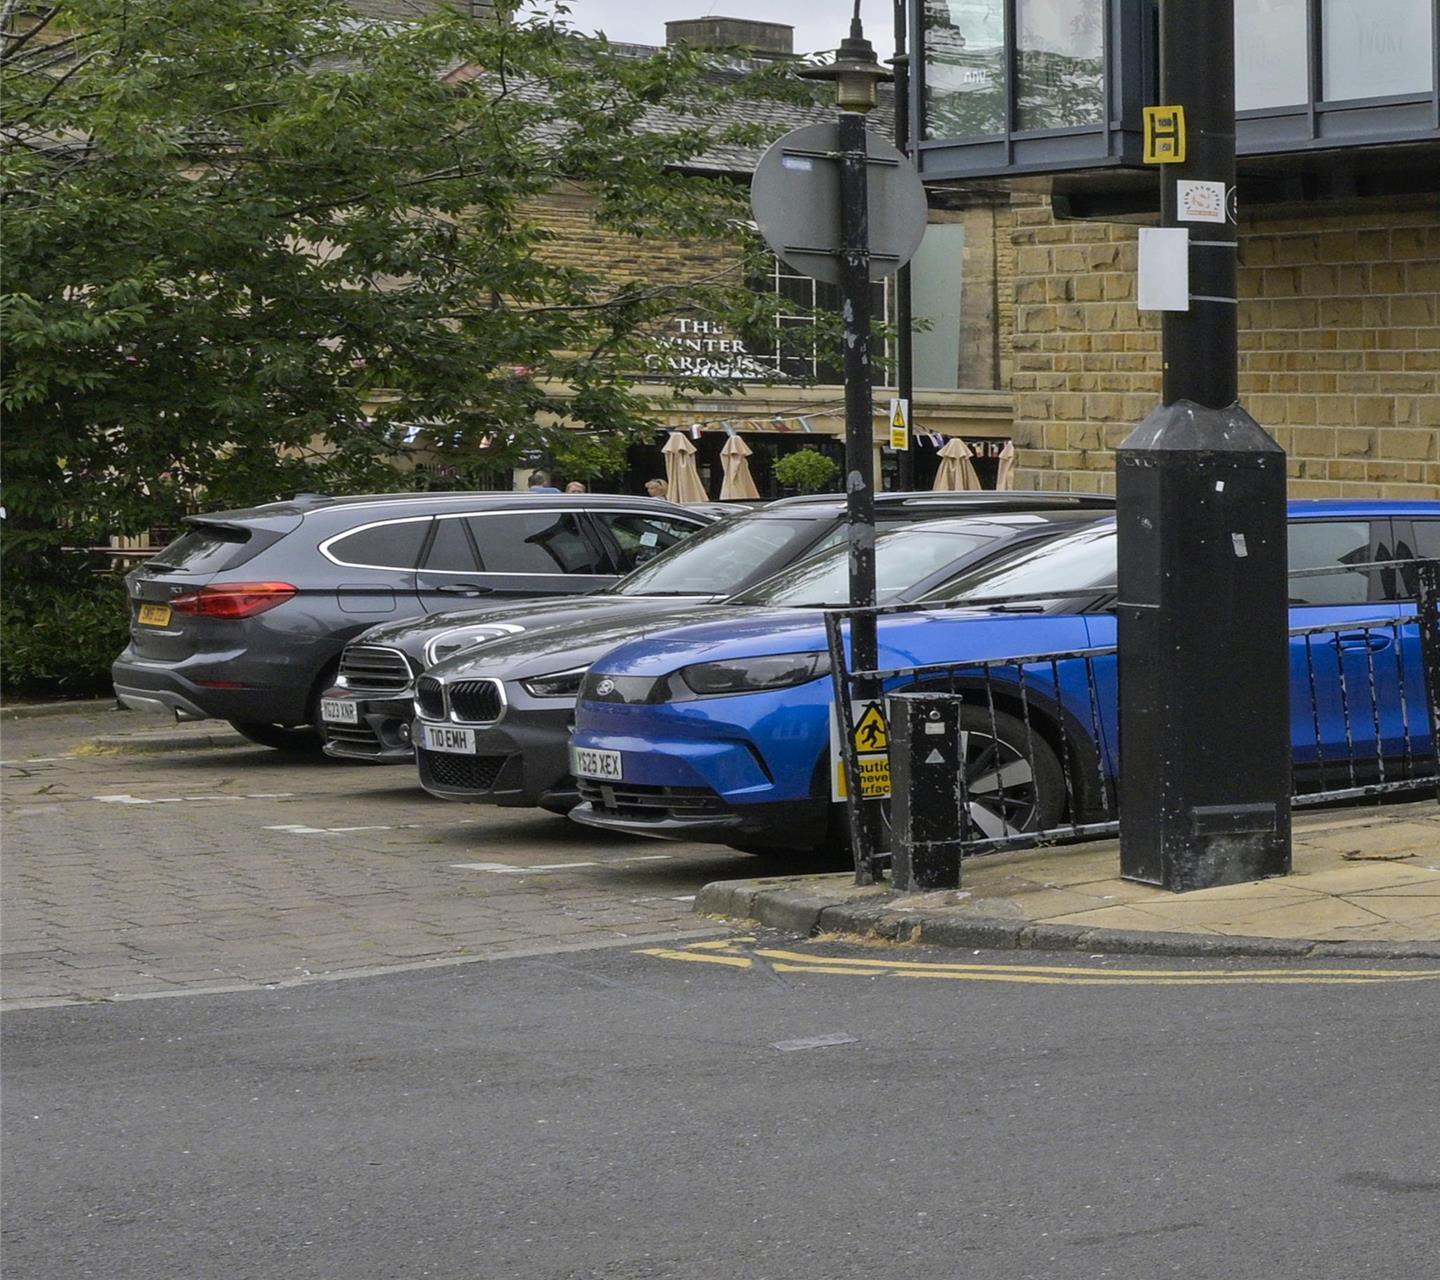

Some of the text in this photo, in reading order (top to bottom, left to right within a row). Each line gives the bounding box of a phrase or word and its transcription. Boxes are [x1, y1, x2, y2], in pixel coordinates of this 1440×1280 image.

[674, 318, 723, 334] THE
[651, 336, 748, 353] WINTER
[445, 729, 467, 749] EMH
[599, 754, 619, 776] XEX
[858, 761, 890, 774] autio
[860, 775, 886, 783] neve
